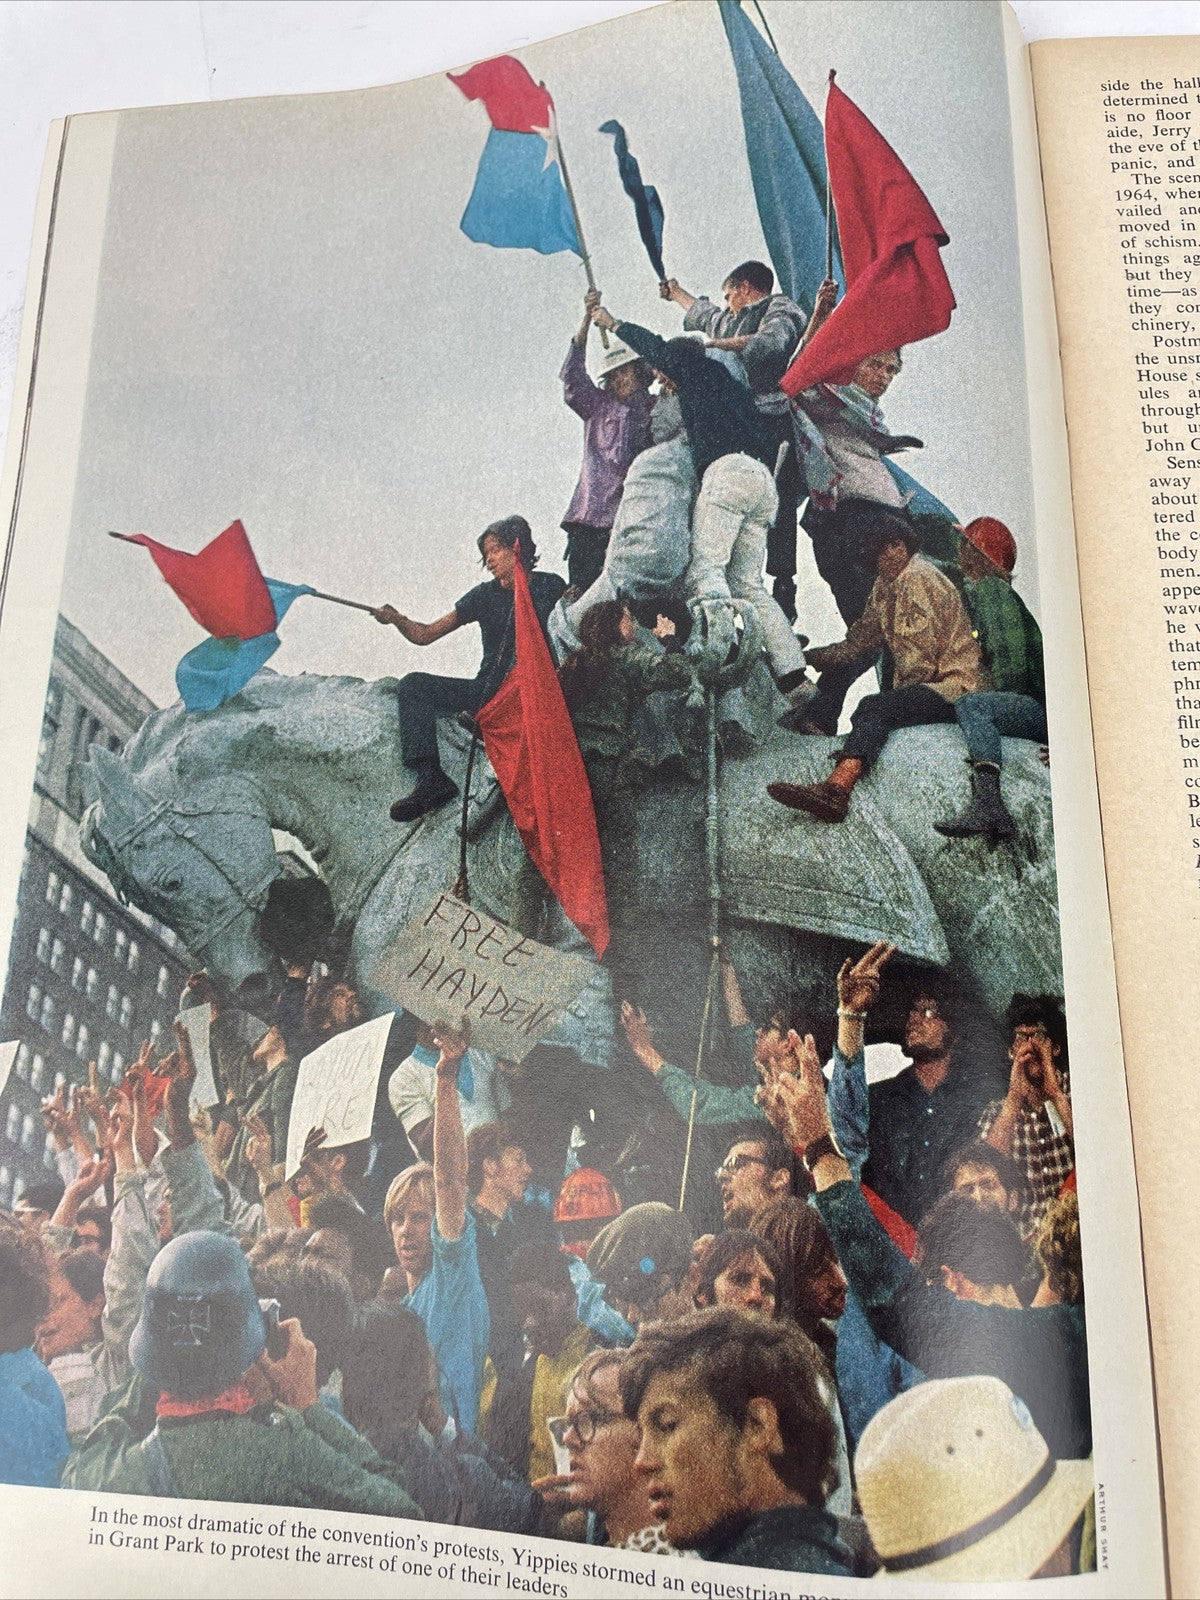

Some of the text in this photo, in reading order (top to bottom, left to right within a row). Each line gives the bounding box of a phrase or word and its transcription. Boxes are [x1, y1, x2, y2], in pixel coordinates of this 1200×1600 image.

[1101, 78, 1200, 91] side the hall
[1103, 93, 1188, 106] determined
[1105, 109, 1191, 122] is no floor
[1107, 125, 1191, 138] aide, Jerry
[1109, 143, 1132, 153] the
[1138, 143, 1164, 152] eve
[1170, 140, 1186, 151] of
[1111, 156, 1195, 173] panic, and
[1131, 174, 1162, 184] The
[1115, 189, 1157, 201] 1964,
[1116, 205, 1162, 216] vailed
[1119, 220, 1195, 232] moved in
[1121, 236, 1137, 248] of
[1123, 252, 1169, 267] things
[1125, 269, 1192, 282] but they
[1129, 302, 1162, 316] they
[1132, 319, 1195, 333] chinery,
[1135, 353, 1159, 365] the
[1137, 370, 1188, 382] House
[1139, 387, 1169, 399] ules
[1142, 422, 1169, 434] but
[1146, 439, 1185, 452] John
[1150, 476, 1191, 489] away
[1152, 493, 1198, 505] about
[1154, 510, 1195, 523] tered
[1156, 529, 1181, 541] the
[1158, 546, 1197, 562] body
[1161, 567, 1200, 577] men.
[1164, 604, 1200, 614] wav
[1166, 620, 1186, 633] he
[424, 896, 534, 966] FREE
[408, 949, 552, 1035] HAYDEN
[1098, 1483, 1109, 1570] ARTHUR SHAY
[91, 1506, 108, 1523] In
[113, 1509, 138, 1525] the
[143, 1514, 183, 1529] most
[188, 1514, 263, 1535] dramatic
[268, 1519, 287, 1536] of
[291, 1522, 317, 1539] the
[432, 1538, 505, 1565] protests,
[512, 1547, 578, 1575] Yippies
[583, 1562, 656, 1587] stormed
[663, 1577, 684, 1591] an
[691, 1580, 790, 1600] equestrian
[89, 1528, 568, 1598] in Grant Park to protest the arrest of one of their leaders
